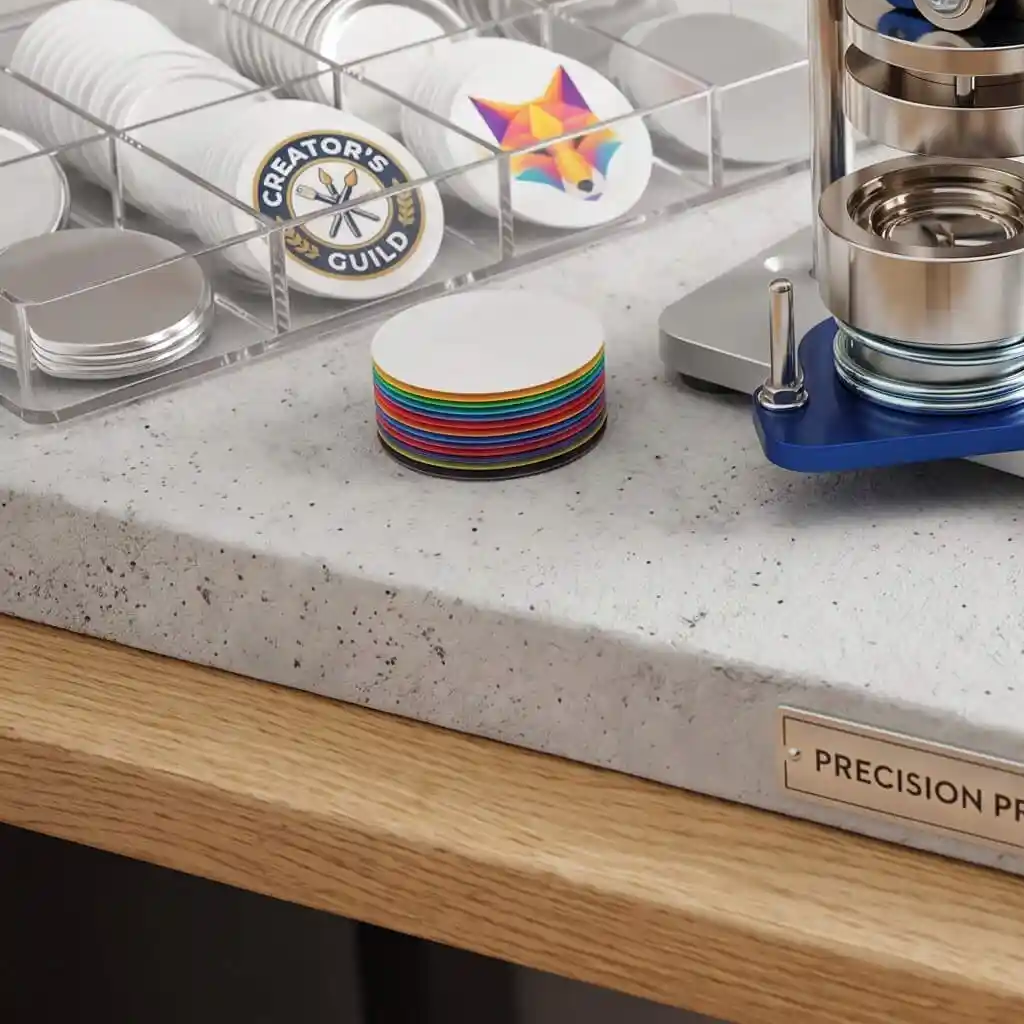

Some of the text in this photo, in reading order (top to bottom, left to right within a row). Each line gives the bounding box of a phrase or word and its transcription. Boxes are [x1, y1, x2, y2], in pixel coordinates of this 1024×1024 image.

[262, 136, 390, 208] CREATOR'S
[327, 231, 409, 273] GUILD
[815, 749, 983, 813] PRECISION
